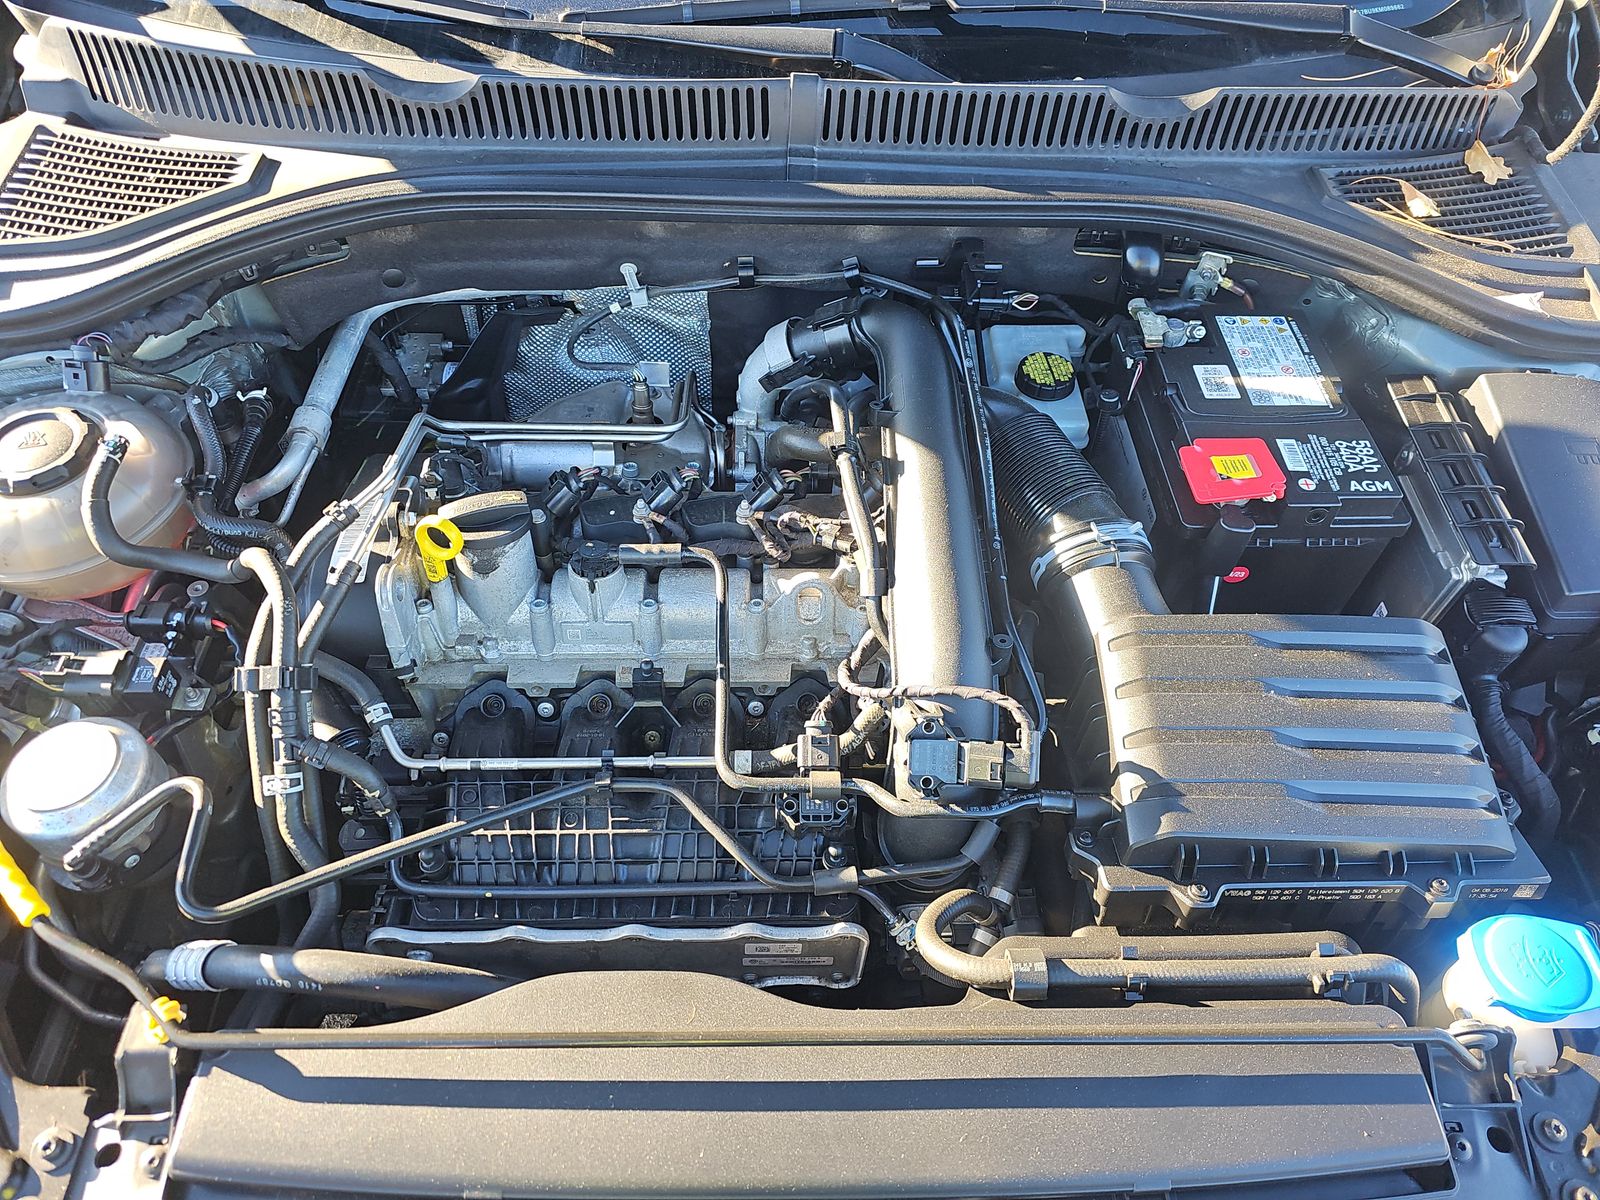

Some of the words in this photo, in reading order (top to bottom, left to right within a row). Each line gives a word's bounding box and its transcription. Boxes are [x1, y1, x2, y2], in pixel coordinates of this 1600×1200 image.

[1334, 440, 1364, 473] 640A
[1351, 440, 1381, 473] 58Ah
[1350, 480, 1394, 492] AGM
